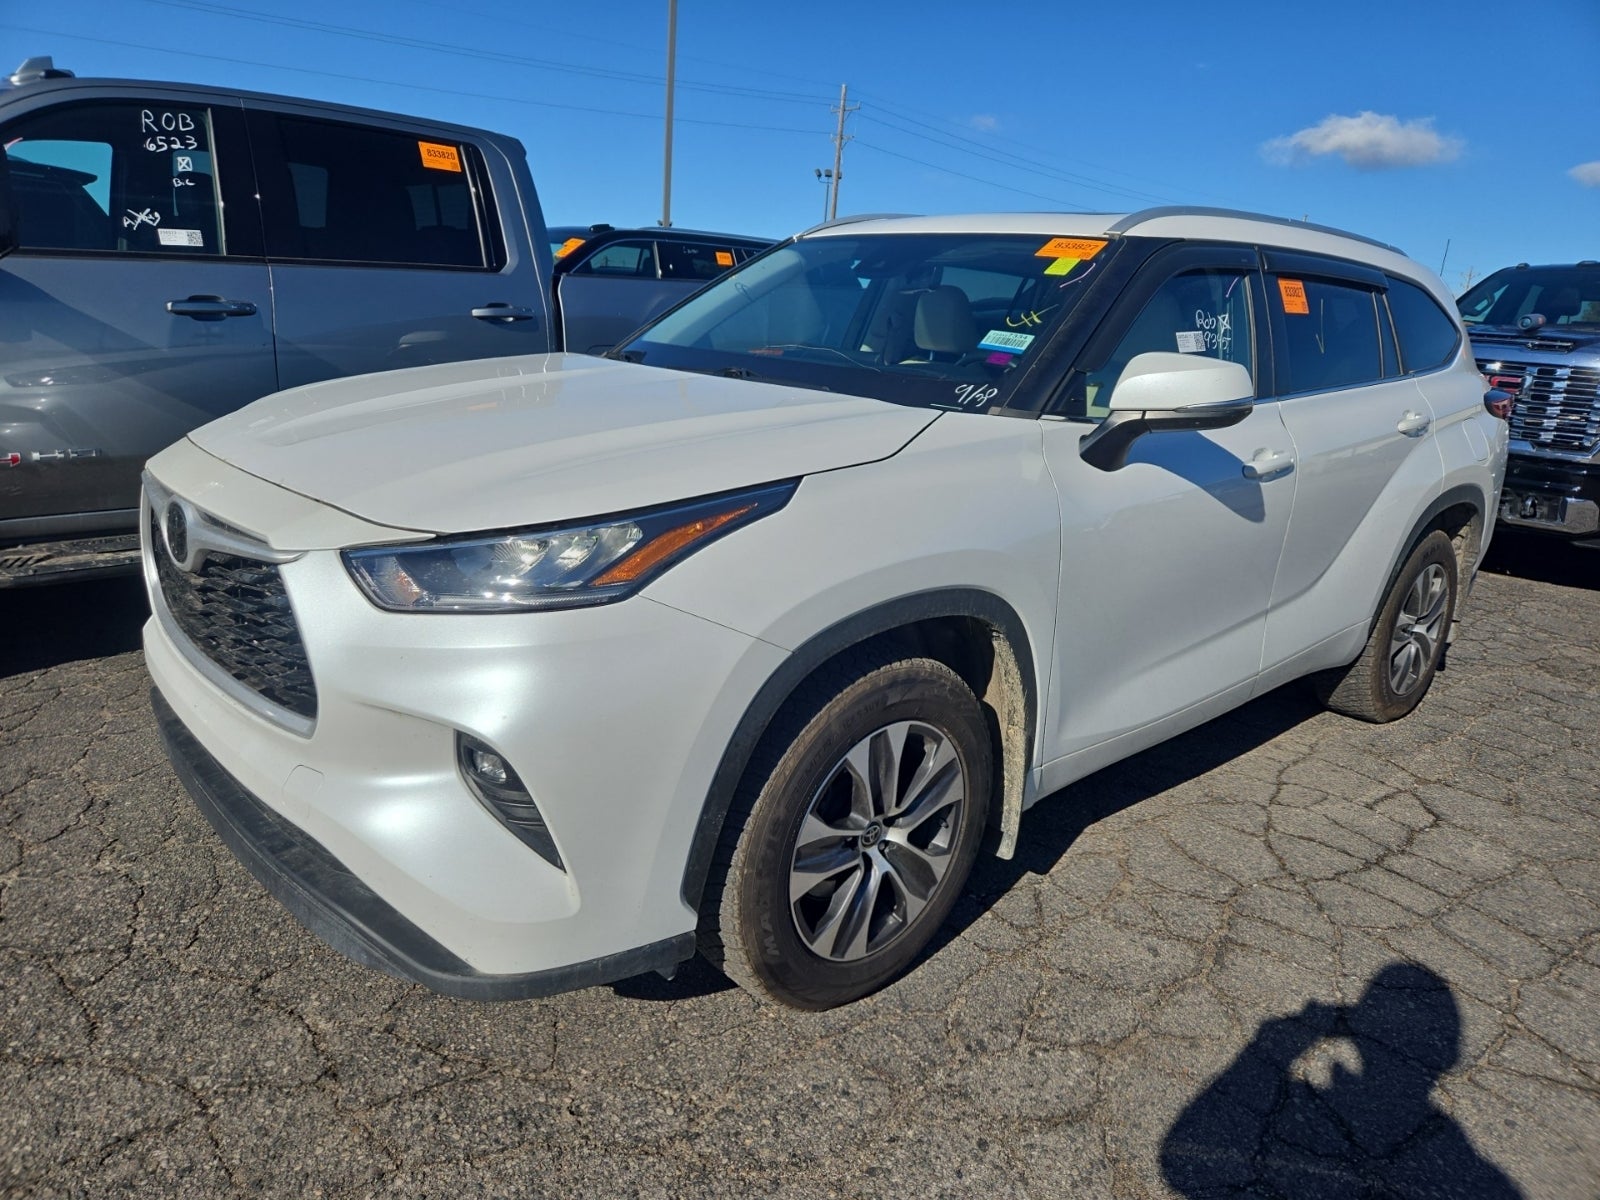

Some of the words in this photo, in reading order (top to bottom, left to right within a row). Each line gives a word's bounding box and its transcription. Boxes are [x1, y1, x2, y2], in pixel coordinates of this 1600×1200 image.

[141, 109, 195, 133] ROB
[144, 135, 198, 153] 6523
[1054, 242, 1099, 251] 833827
[954, 383, 998, 408] 9/30
